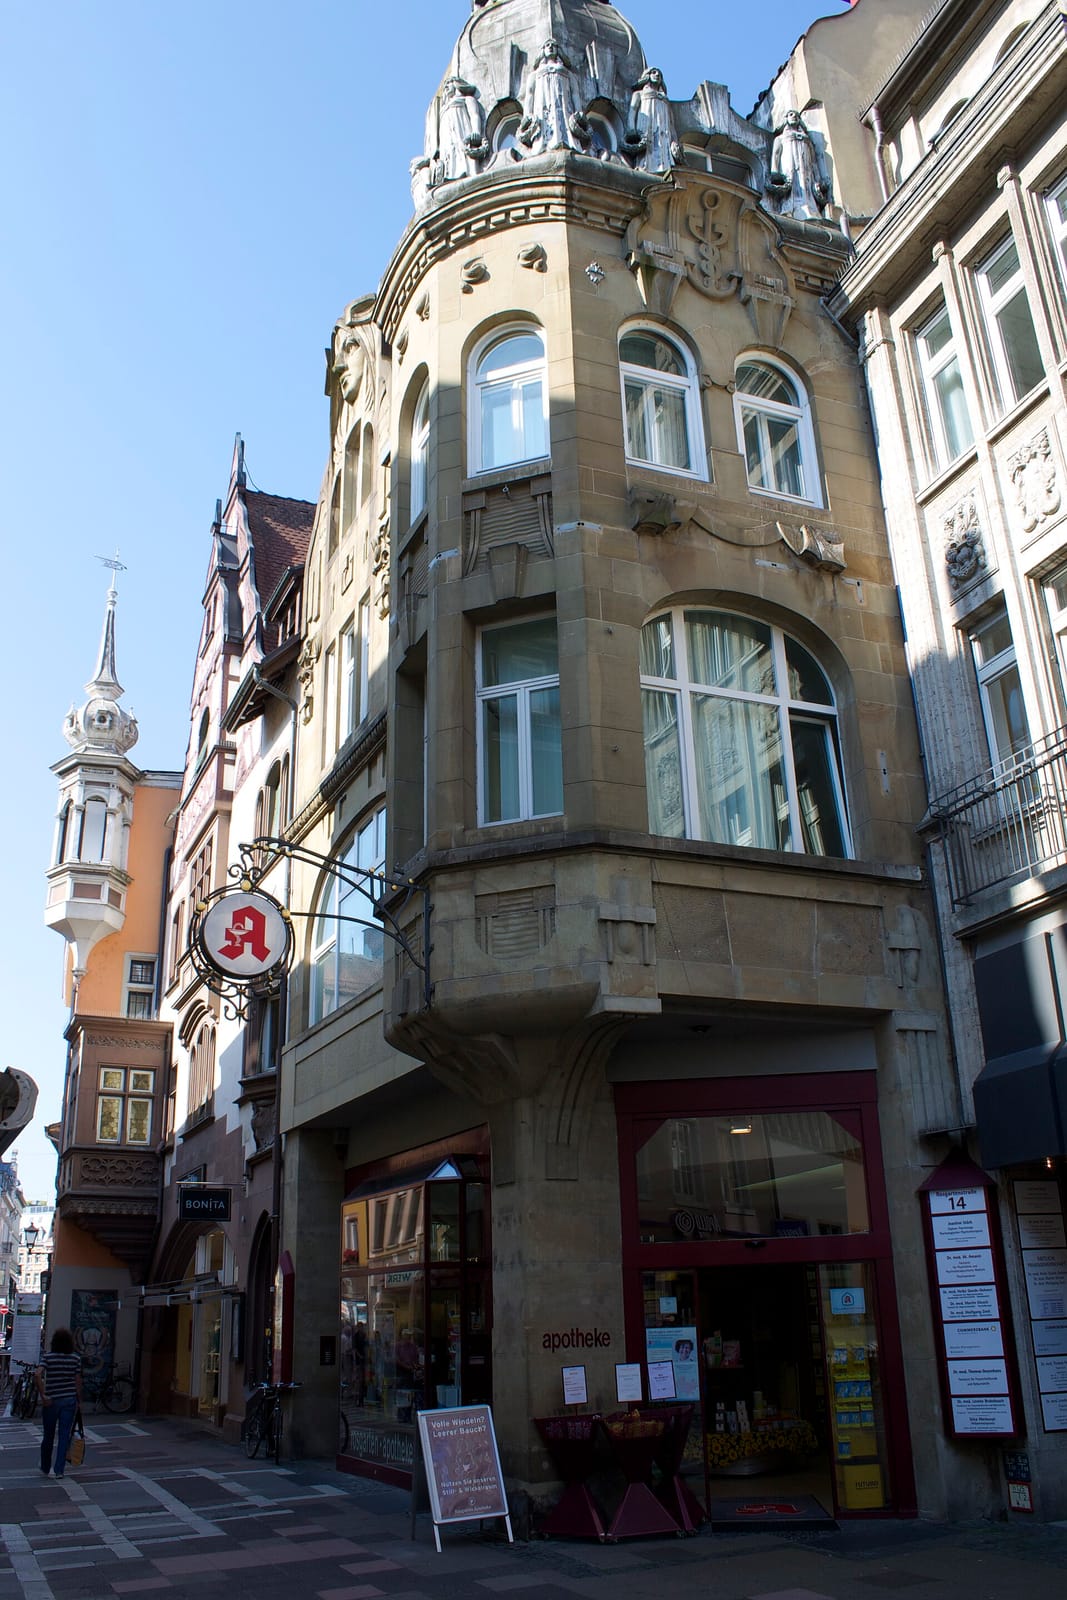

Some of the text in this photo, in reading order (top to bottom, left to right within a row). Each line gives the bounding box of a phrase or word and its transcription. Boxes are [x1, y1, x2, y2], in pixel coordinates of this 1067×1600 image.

[185, 1198, 225, 1212] BONITA
[948, 1196, 967, 1210] 14
[542, 1328, 611, 1353] apotheke
[431, 1416, 485, 1428] Volle Windeln?
[433, 1425, 487, 1438] Leerer Bauch?
